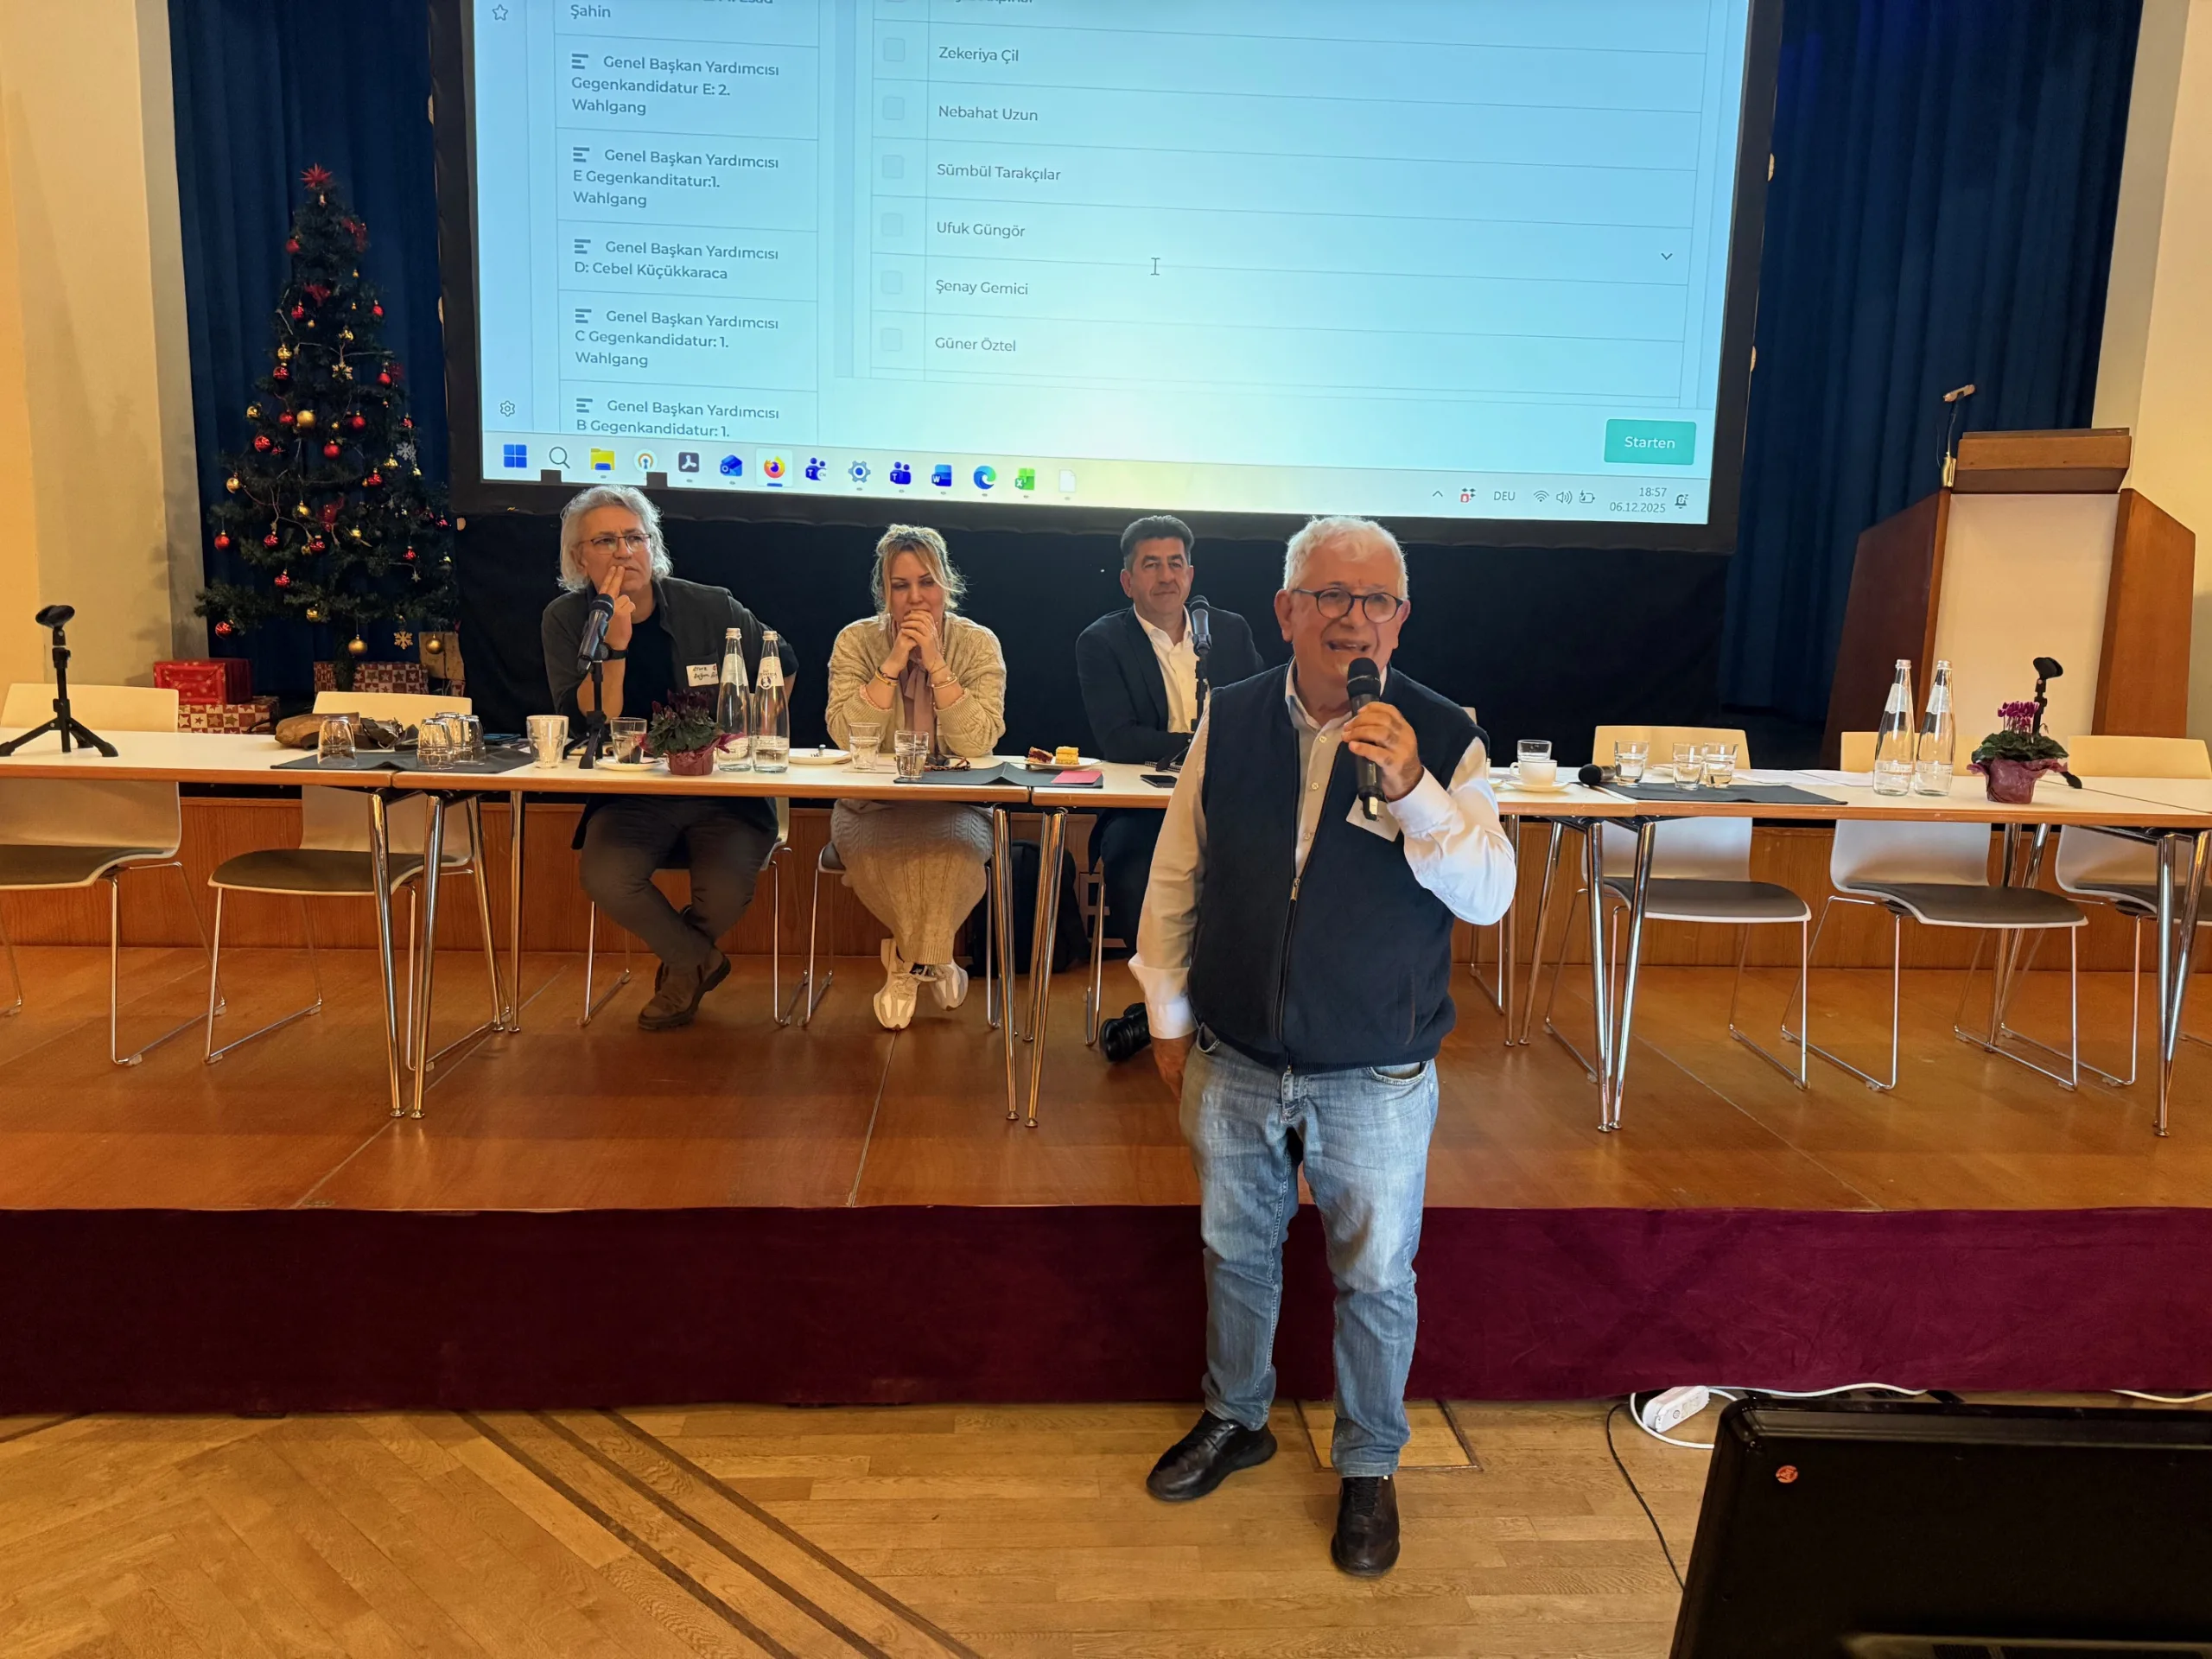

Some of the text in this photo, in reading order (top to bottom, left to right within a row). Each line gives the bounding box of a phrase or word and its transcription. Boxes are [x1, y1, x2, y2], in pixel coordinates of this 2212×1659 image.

[570, 3, 611, 19] Şahin
[938, 46, 1019, 64] Zekeriya Çil
[603, 56, 779, 76] Genel Başkan Yardımcısı
[571, 77, 730, 96] Gegenkandidatur E: 2.
[571, 99, 646, 116] Wahlgang
[938, 105, 1039, 121] Nebahat Uzun
[604, 149, 779, 169] Genel Başkan Yardımcısı
[573, 170, 582, 182] E
[937, 163, 1061, 182] Sümbül Tarakçılar
[573, 191, 647, 208] Wahlgang
[936, 221, 1026, 238] Ufuk Güngör
[605, 241, 779, 260] Genel Başkan Yardımcısı
[574, 261, 728, 281] D: Cebel Küçükkaraca
[935, 279, 1029, 296] Şenay Gemici
[606, 310, 779, 330] Genel Başkan Yardımcısı
[575, 330, 729, 348] C Gegenkandidatur: 1.
[935, 336, 1017, 352] Güner Öztel
[575, 351, 649, 369] Wahlgang
[607, 399, 779, 419] Genel Başkan Yardımcısı
[576, 419, 730, 437] B Gegenkandidatur: 1.
[1624, 435, 1675, 448] Starten
[1493, 491, 1516, 501] DEU
[1639, 487, 1667, 498] 18:57
[1610, 502, 1666, 513] 06.12.2025
